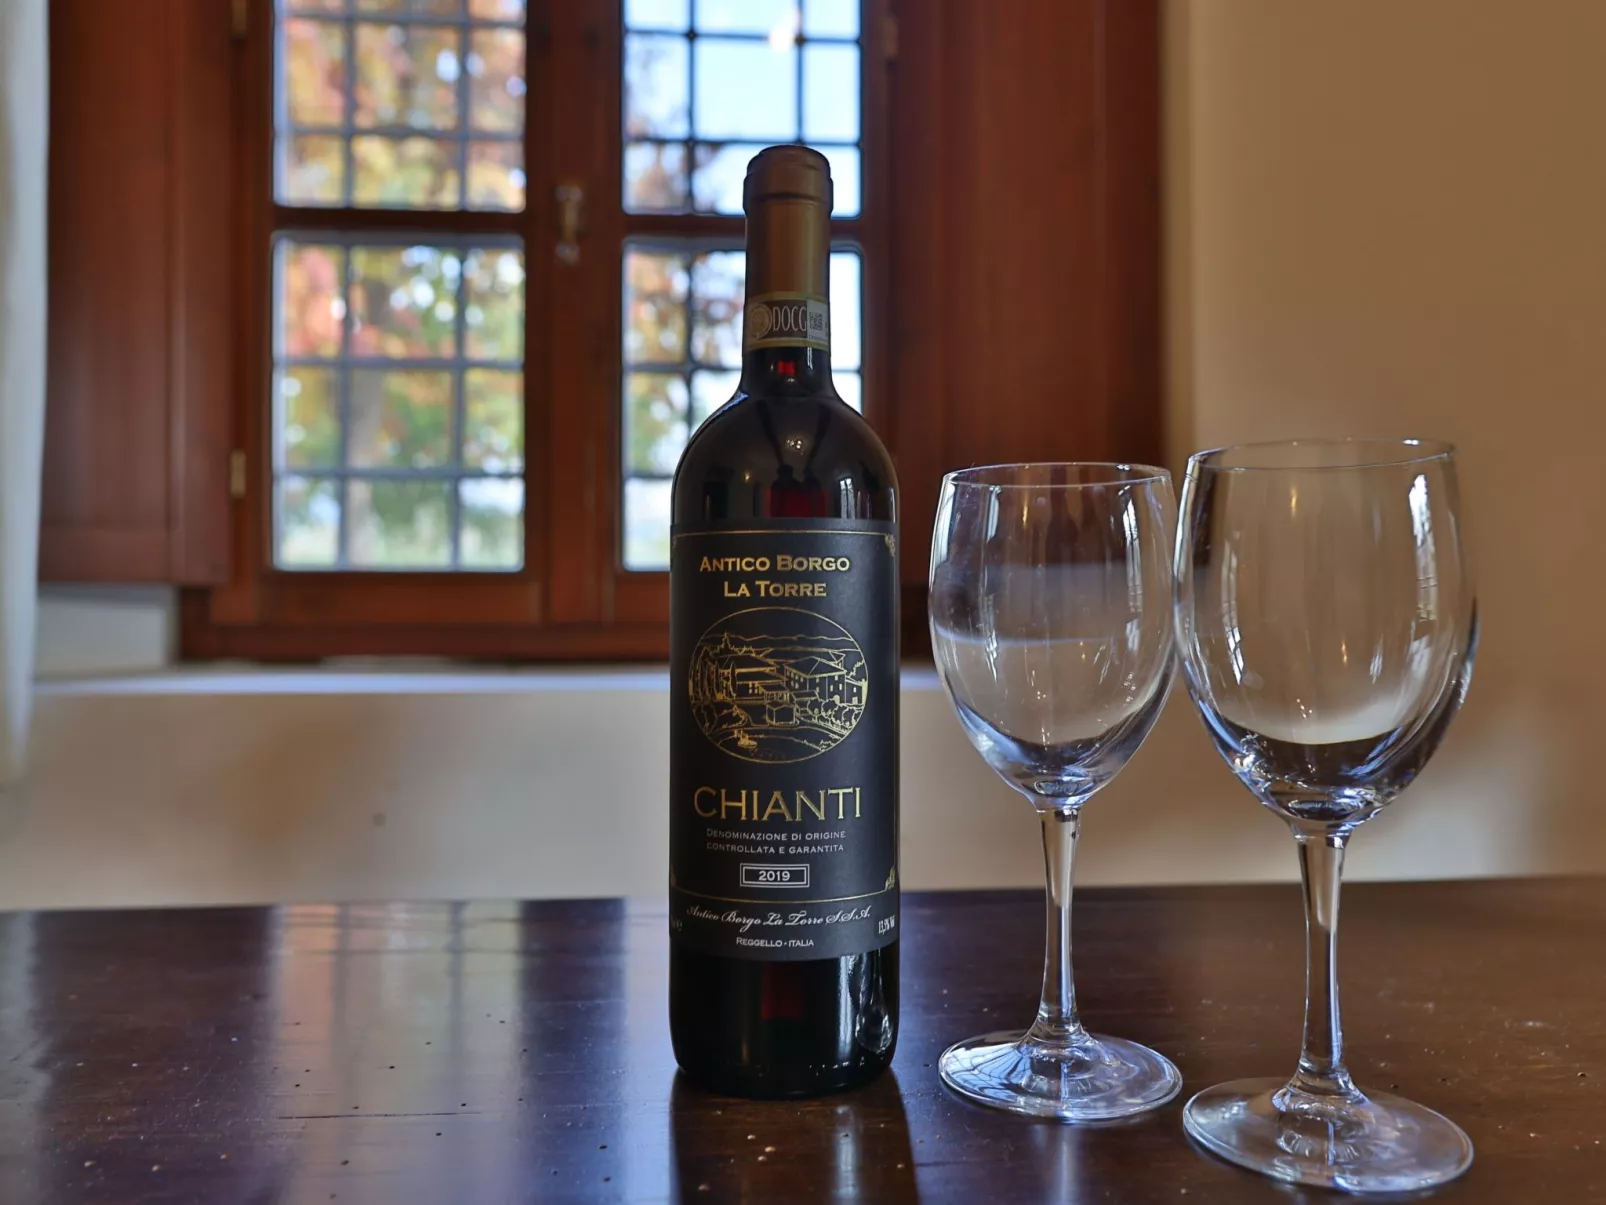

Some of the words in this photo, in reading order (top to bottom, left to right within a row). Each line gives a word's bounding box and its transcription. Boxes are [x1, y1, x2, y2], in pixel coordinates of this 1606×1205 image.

[772, 305, 807, 332] DOCG
[700, 556, 770, 572] ANTICO
[776, 555, 850, 572] BORGO
[724, 581, 750, 597] LA
[755, 580, 827, 597] TORRE
[693, 786, 861, 822] CHIANTI
[706, 828, 788, 841] DENOMINAZIONE
[791, 831, 802, 841] DI
[805, 830, 846, 841] ORIGINE
[706, 842, 775, 854] CONTROLLATA
[779, 845, 785, 854] E
[788, 844, 844, 854] GARANTITA
[758, 870, 791, 882] 2019
[686, 905, 719, 920] Antico
[721, 910, 761, 933] Borgo
[763, 912, 783, 925] La
[785, 910, 823, 926] Torre
[736, 936, 783, 948] REGGELLO
[788, 939, 814, 948] ITALIA
